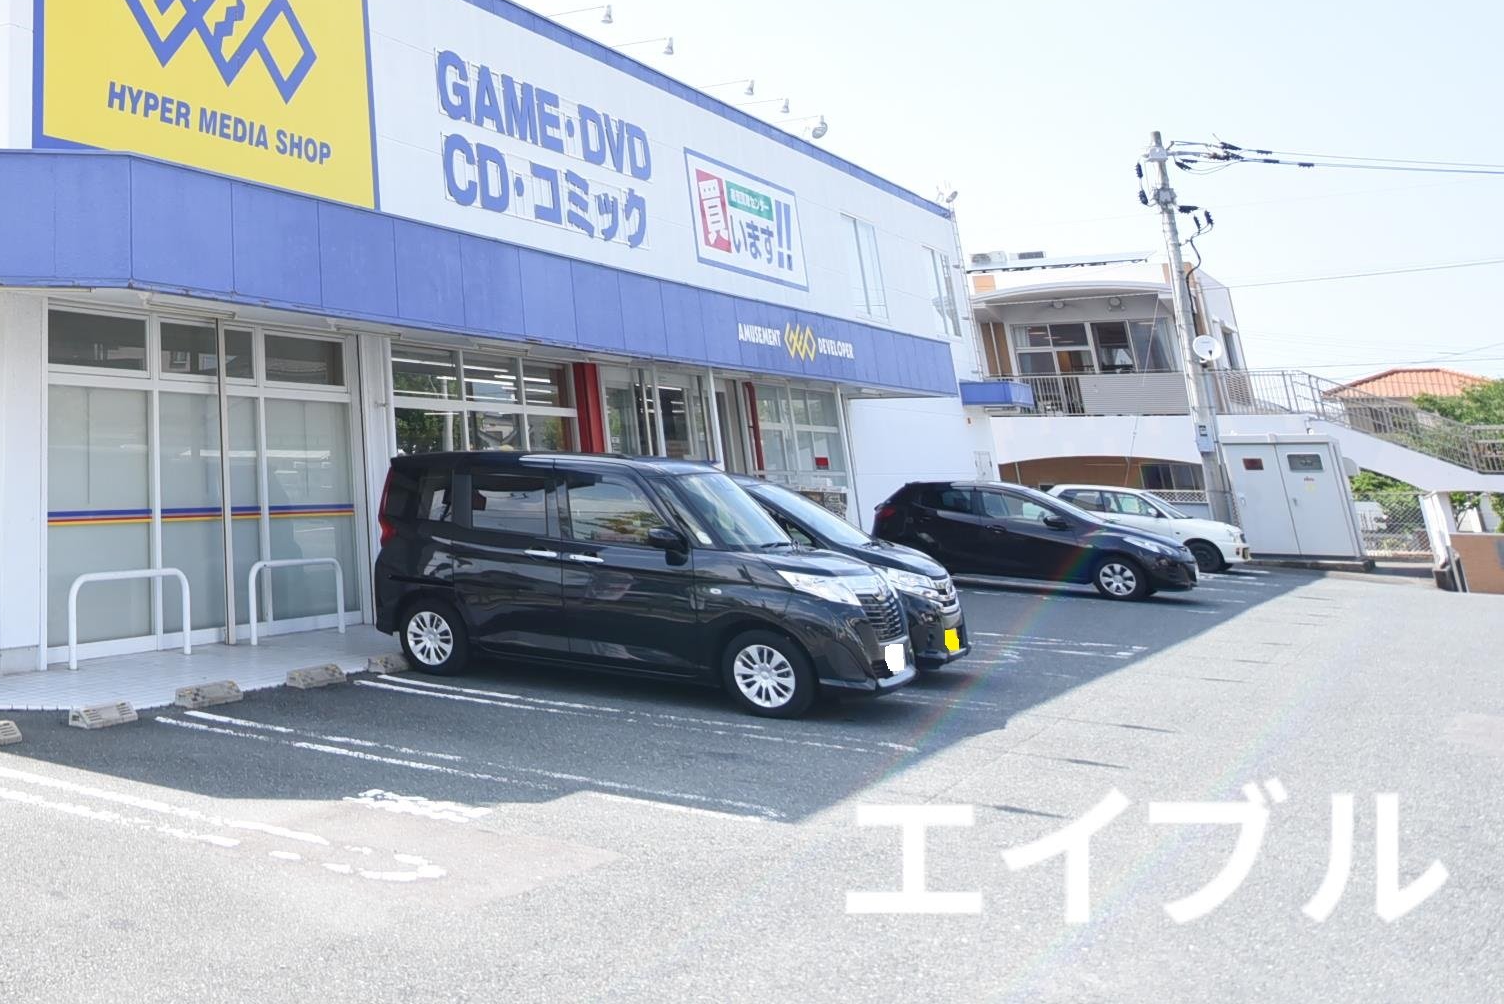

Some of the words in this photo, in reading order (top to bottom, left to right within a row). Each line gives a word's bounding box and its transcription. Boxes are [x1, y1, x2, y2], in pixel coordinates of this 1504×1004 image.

[107, 80, 191, 129] HYPER
[198, 106, 269, 150] MEDIA
[275, 128, 332, 166] SHOP
[737, 322, 782, 347] AMUSEMENT
[817, 337, 855, 360] DEVELOPER
